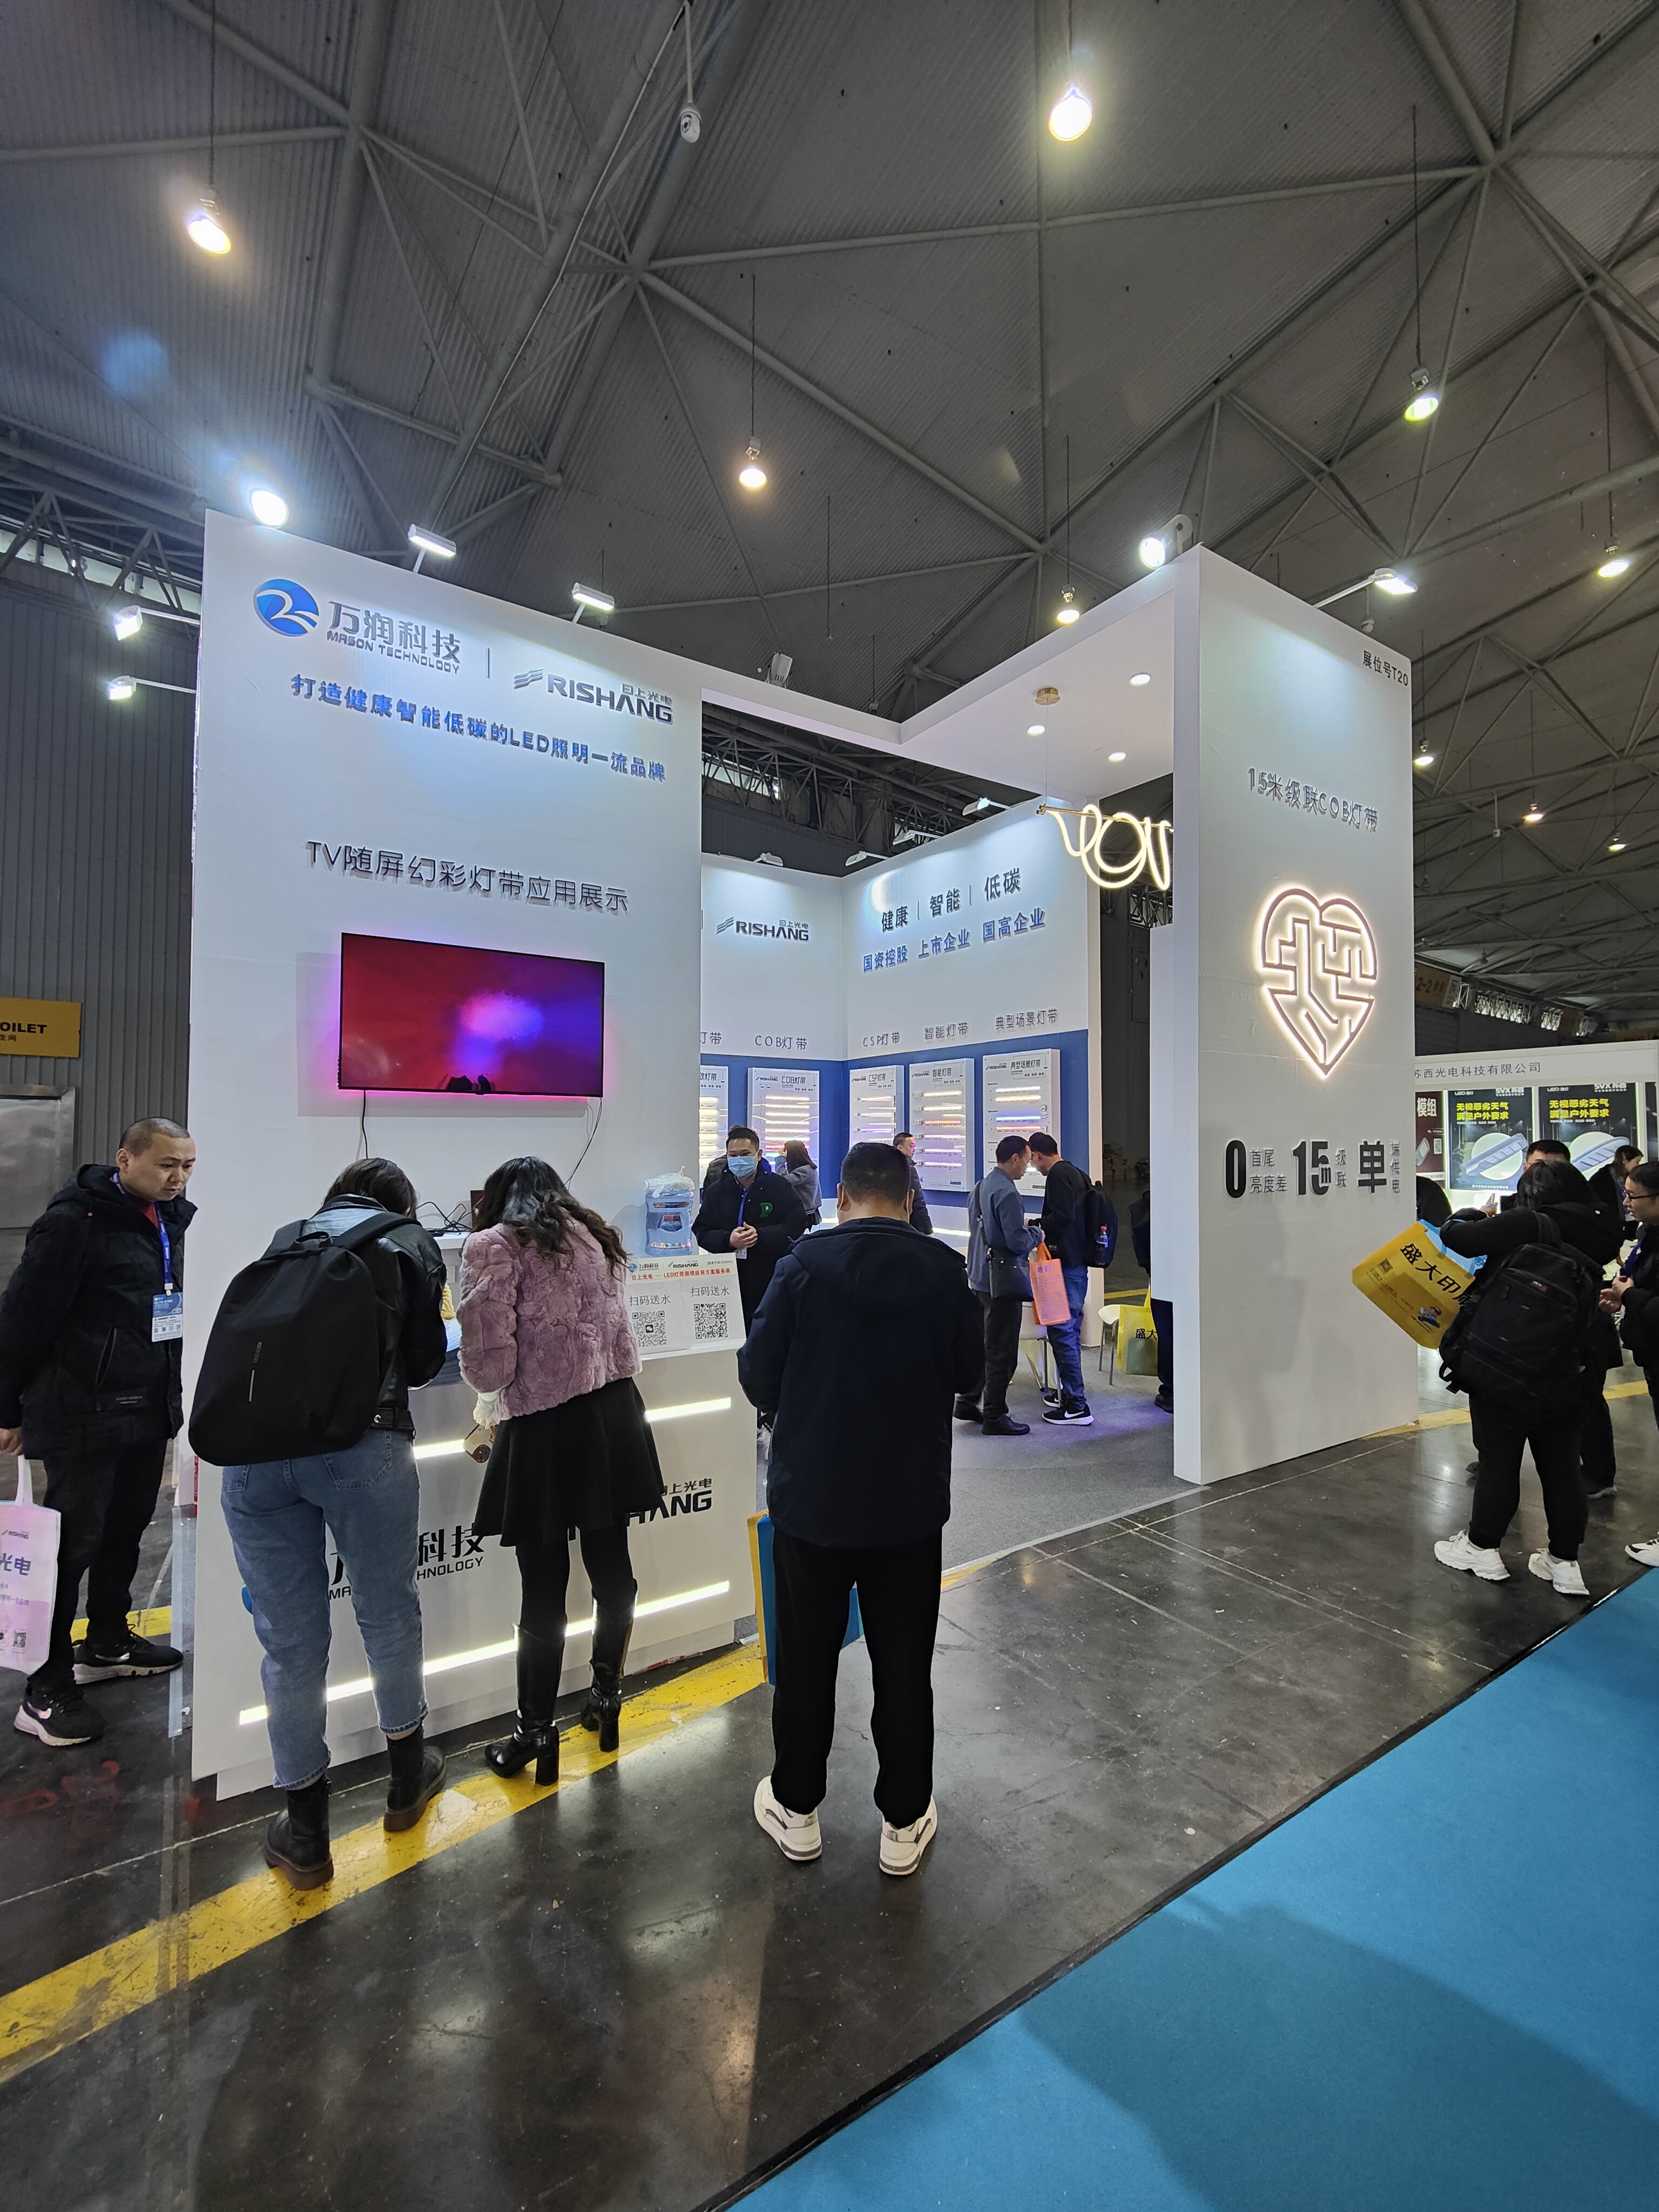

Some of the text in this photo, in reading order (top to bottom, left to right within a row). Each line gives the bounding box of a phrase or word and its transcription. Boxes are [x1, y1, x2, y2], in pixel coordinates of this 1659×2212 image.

[328, 600, 461, 664] 万润科技
[327, 630, 460, 675] MASON TECHNOLOGY
[1363, 650, 1408, 686] 展位号T20
[548, 674, 673, 725] RISHANG
[622, 683, 673, 705] 日上光电
[291, 673, 666, 783] 打造健康智能低碳的LED照明一流品牌
[1248, 767, 1378, 832] 15米级联COB灯带
[306, 840, 629, 912] TV随屏幻彩灯带应用展示
[881, 868, 1021, 933] 健康 智能 低碳
[736, 920, 810, 942] RISHANG
[779, 920, 809, 929] 日上光电
[863, 907, 1046, 973] 国资控股 上市企业 国高企业
[995, 1008, 1058, 1030] 典型场景灯带
[863, 1031, 900, 1048] CSP灯带
[923, 1021, 968, 1041] 智能灯带
[755, 1035, 807, 1050] COB灯带
[933, 1068, 952, 1077] 智能灯带
[1010, 1059, 1041, 1070] 典型场景灯带
[781, 1076, 806, 1084] COB灯带
[1417, 1097, 1437, 1117] 模组
[1456, 1102, 1509, 1111] 无视恶劣天气
[1549, 1098, 1609, 1108] 无视恶劣天气
[1456, 1111, 1509, 1121] 满足户外要求
[1549, 1109, 1610, 1119] 满足户外要求
[1250, 1148, 1275, 1166] 首尾
[1357, 1140, 1387, 1193] 单
[1250, 1174, 1287, 1193] 亮度差
[760, 1202, 773, 1218] P
[663, 1267, 731, 1278] LED灯带照明应用方案服务商
[629, 1293, 671, 1306] 扫码送水
[690, 1285, 730, 1297] 扫码送水
[1135, 1327, 1157, 1340] 盛大
